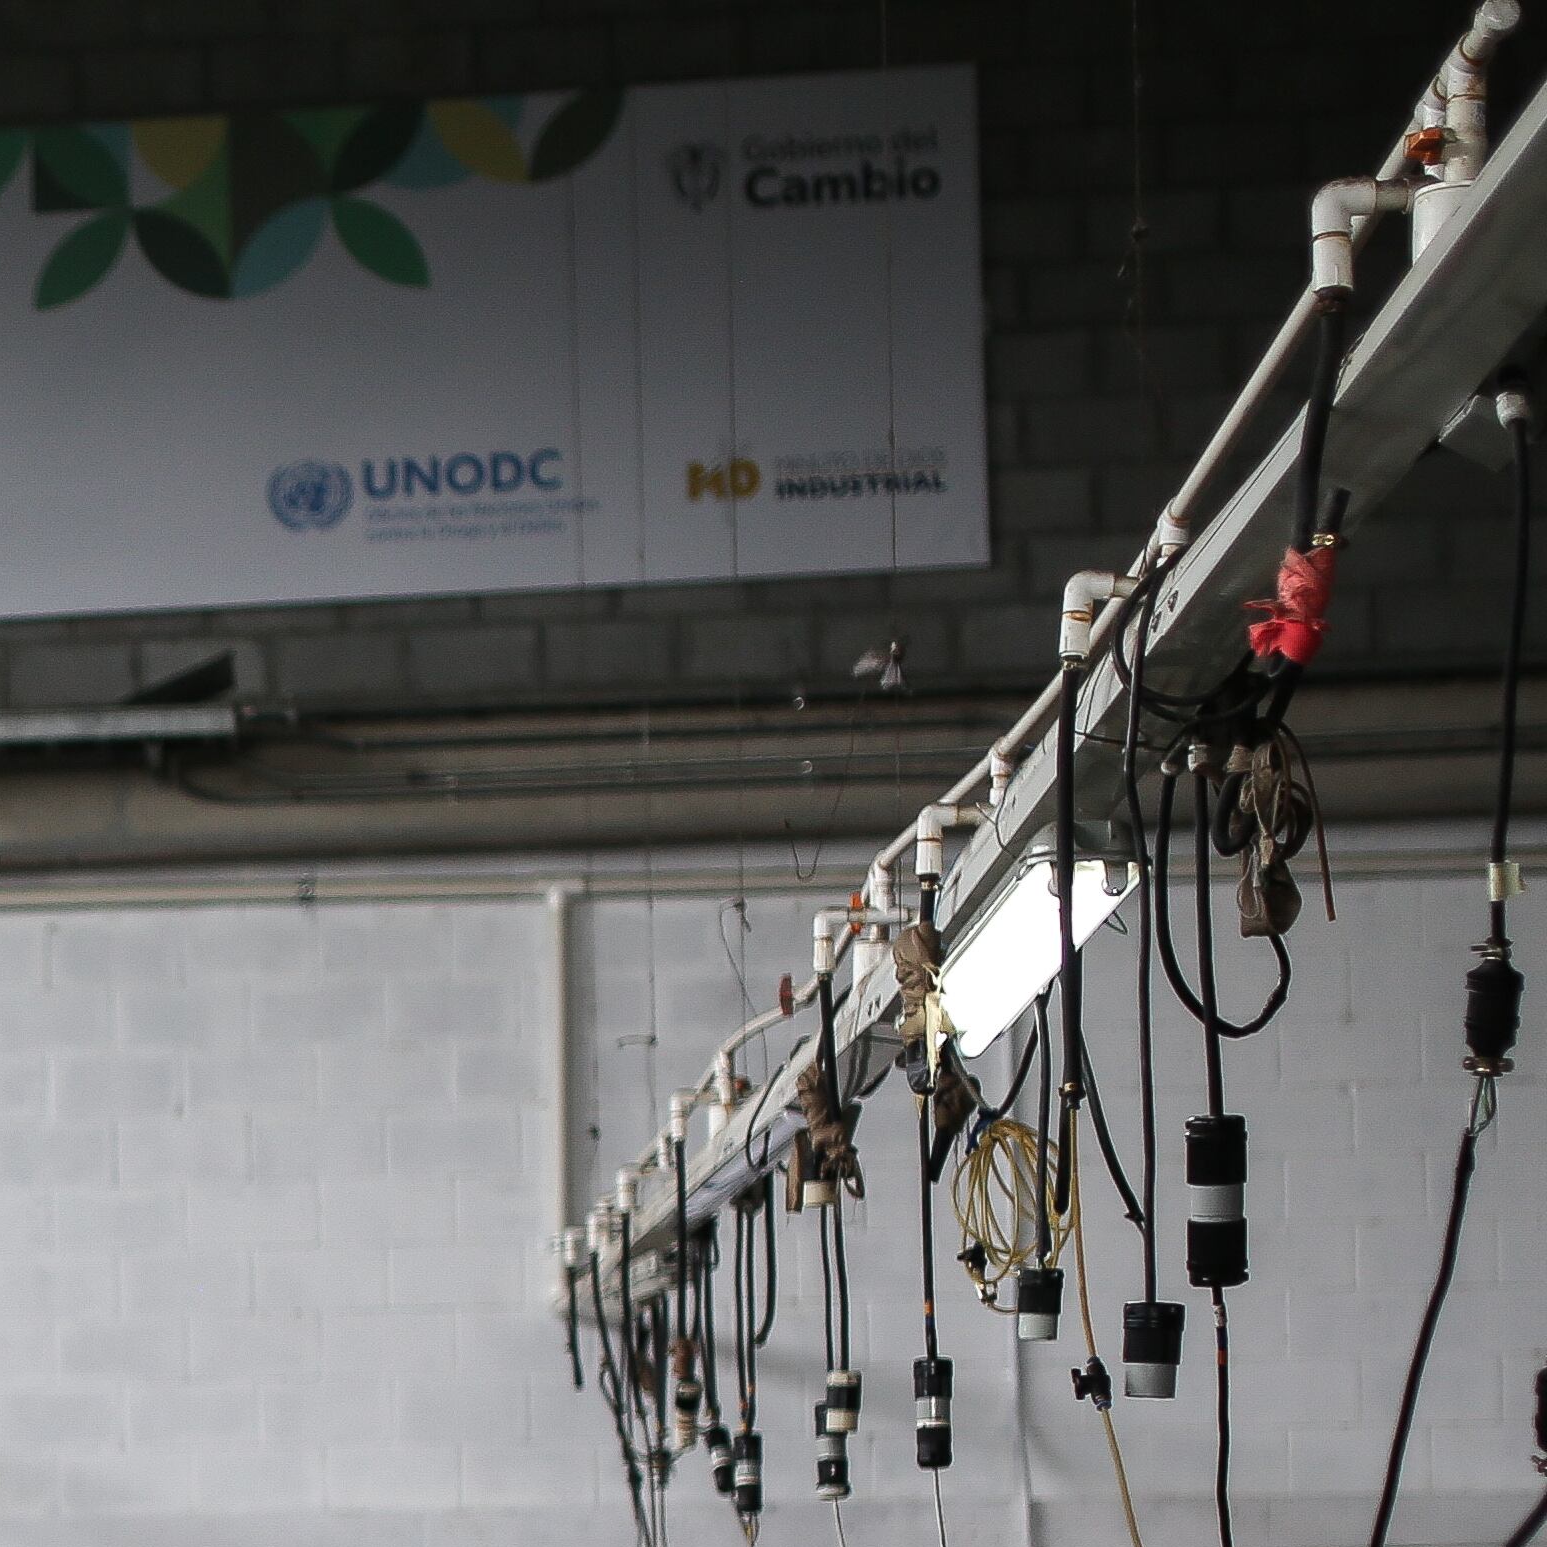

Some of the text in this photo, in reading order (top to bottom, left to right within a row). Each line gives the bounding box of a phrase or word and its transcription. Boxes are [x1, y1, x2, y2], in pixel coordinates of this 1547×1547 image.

[744, 158, 943, 208] Cambio
[361, 447, 564, 500] UNODC
[775, 470, 949, 501] INDUSTRIAL
